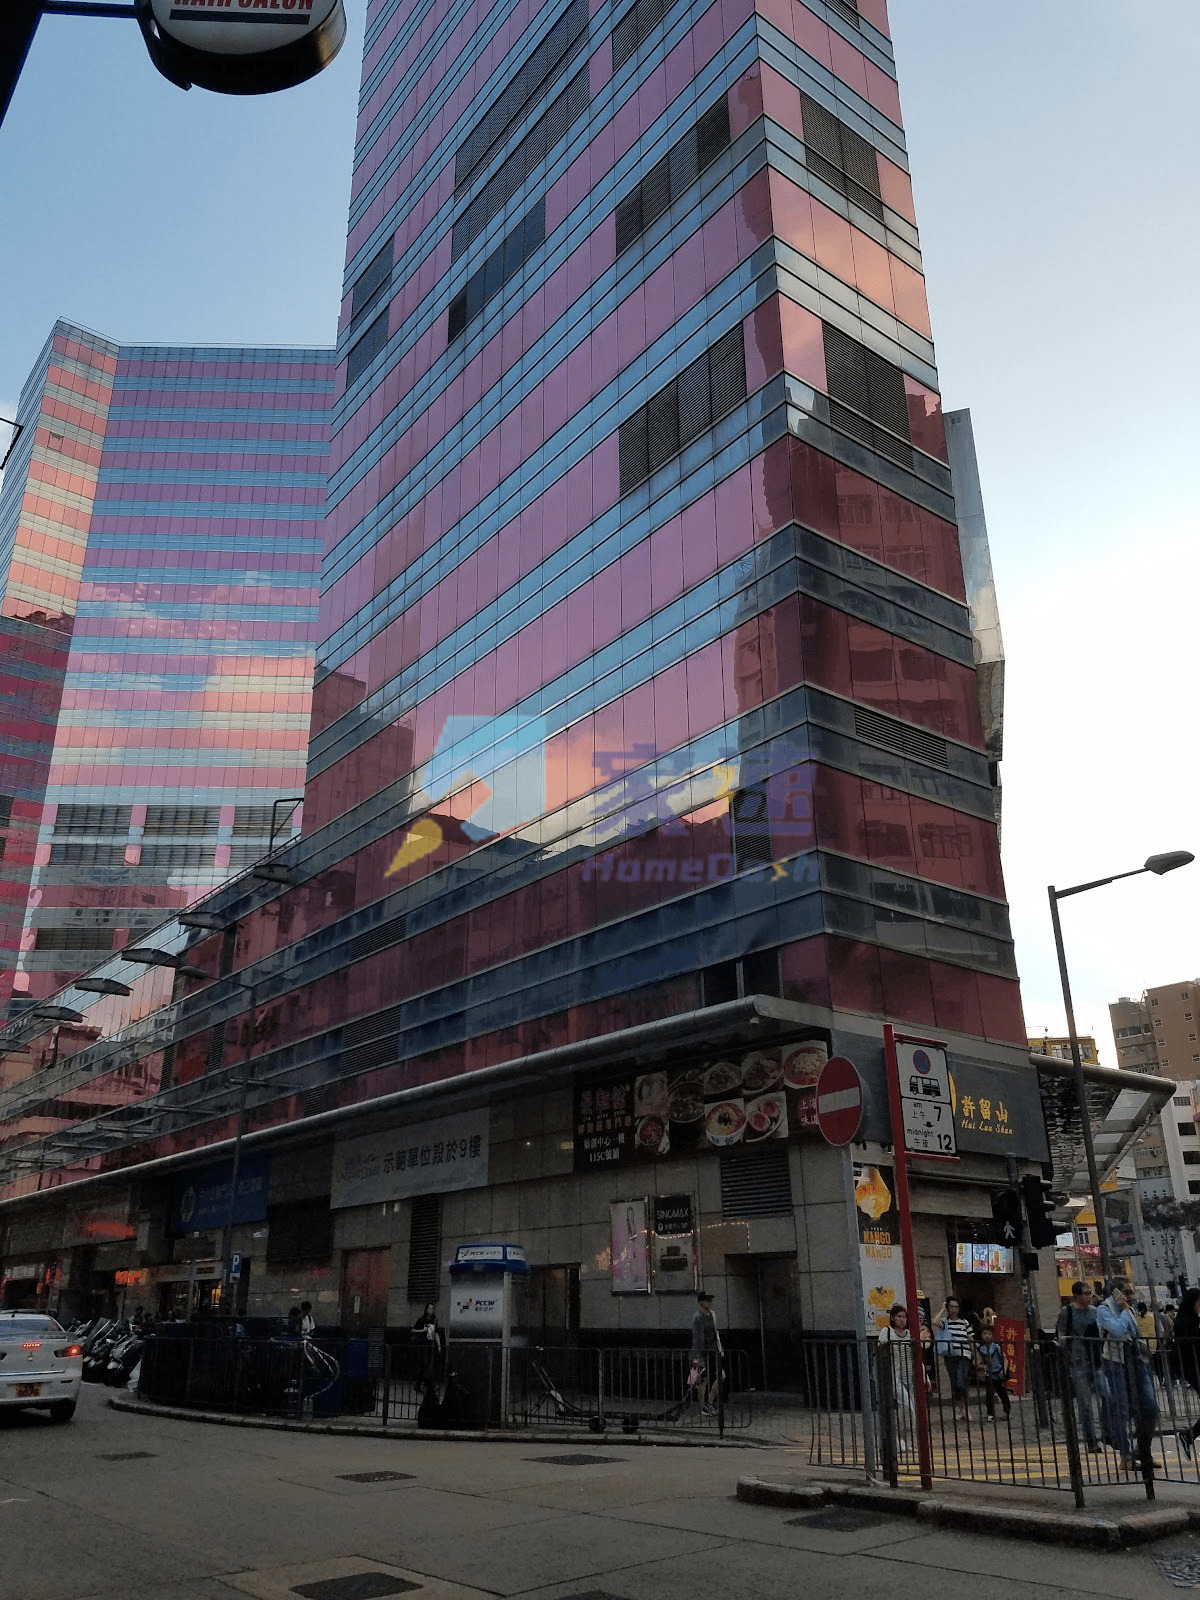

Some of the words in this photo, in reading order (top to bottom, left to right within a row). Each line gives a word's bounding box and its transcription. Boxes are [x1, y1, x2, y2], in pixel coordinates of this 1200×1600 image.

[911, 1109, 926, 1120] 上午
[933, 1105, 942, 1121] 7
[960, 1095, 1009, 1123] 許留山
[906, 1128, 934, 1138] midnight
[914, 1138, 928, 1148] 午夜
[937, 1133, 952, 1150] 12
[383, 1134, 482, 1173] 示範單位設於9樓
[863, 1230, 891, 1245] MANGO
